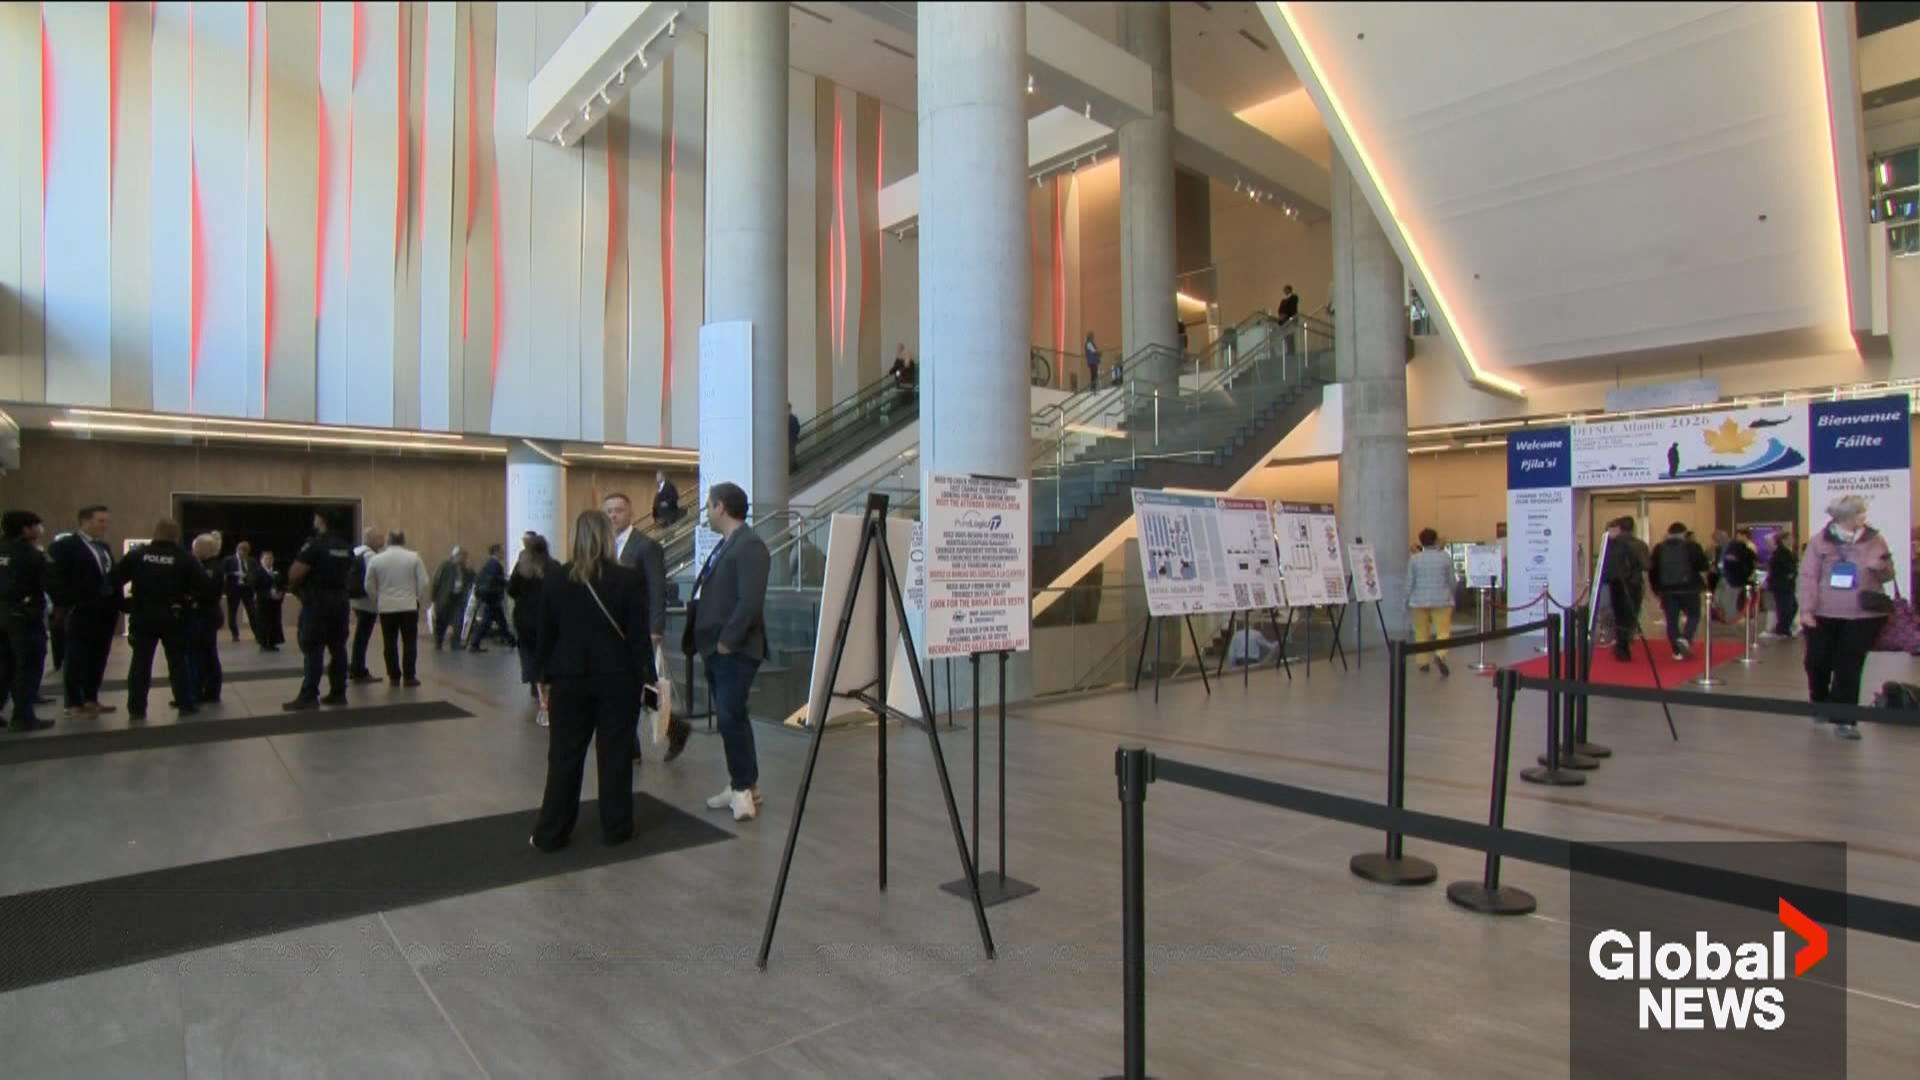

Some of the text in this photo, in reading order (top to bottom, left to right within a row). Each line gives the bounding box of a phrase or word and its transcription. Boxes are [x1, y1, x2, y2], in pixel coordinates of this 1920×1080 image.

[1622, 421, 1665, 433] Atlantic
[1669, 416, 1710, 429] 2026
[1818, 411, 1901, 427] Bienvenue
[1515, 440, 1563, 451] Welcome
[1835, 434, 1882, 449] Fáilte
[1758, 485, 1776, 496] A1
[143, 553, 175, 566] POLICE
[930, 599, 946, 608] LOOK
[946, 599, 958, 608] FOR
[959, 599, 970, 607] THE
